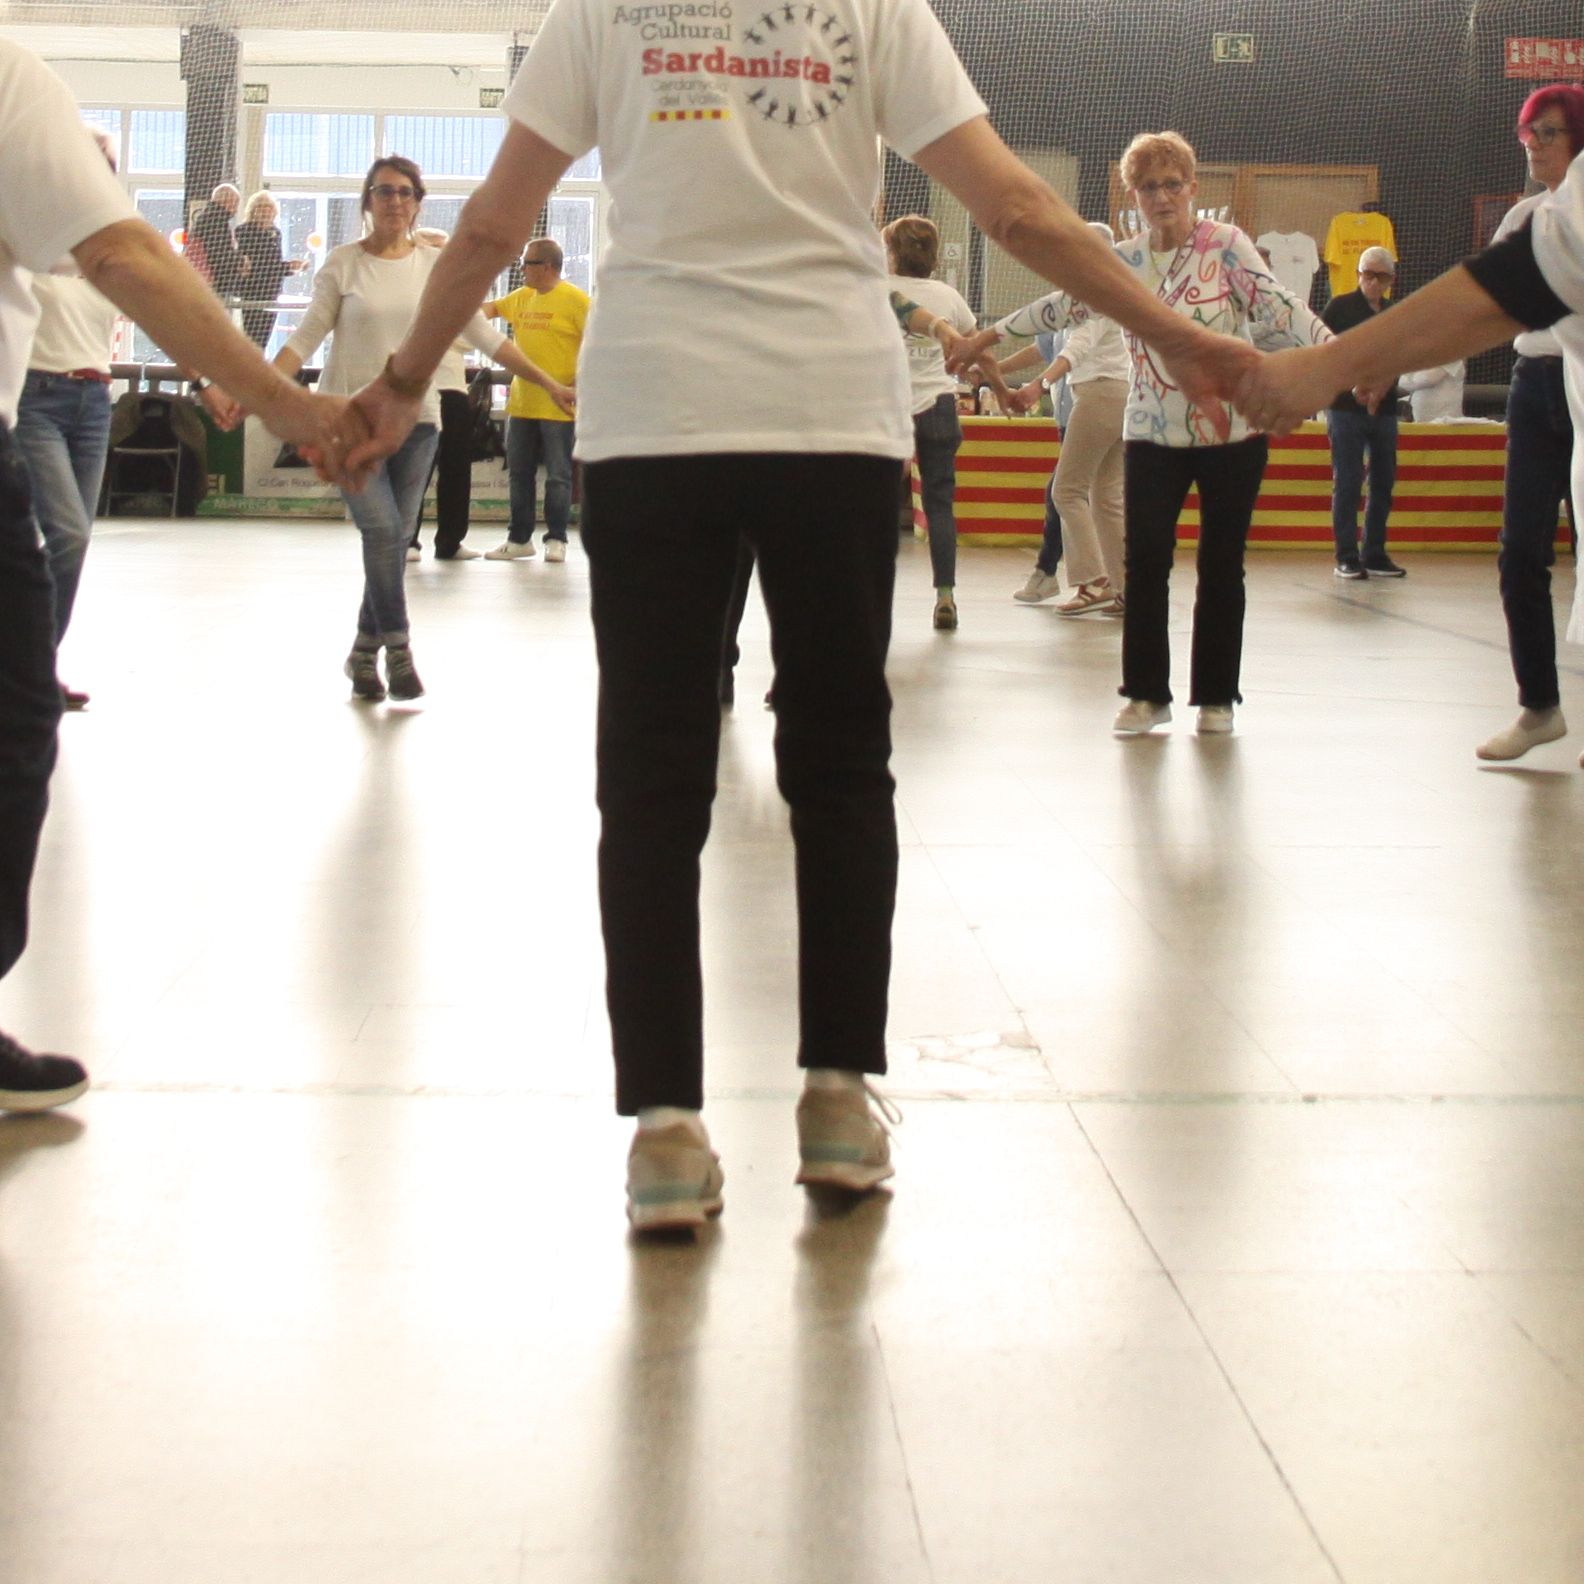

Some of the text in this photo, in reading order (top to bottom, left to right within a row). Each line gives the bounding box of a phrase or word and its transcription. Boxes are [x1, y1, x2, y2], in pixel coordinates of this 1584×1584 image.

[612, 1, 733, 26] Agrupació
[640, 21, 731, 42] Cultural
[642, 47, 831, 84] Sardanista
